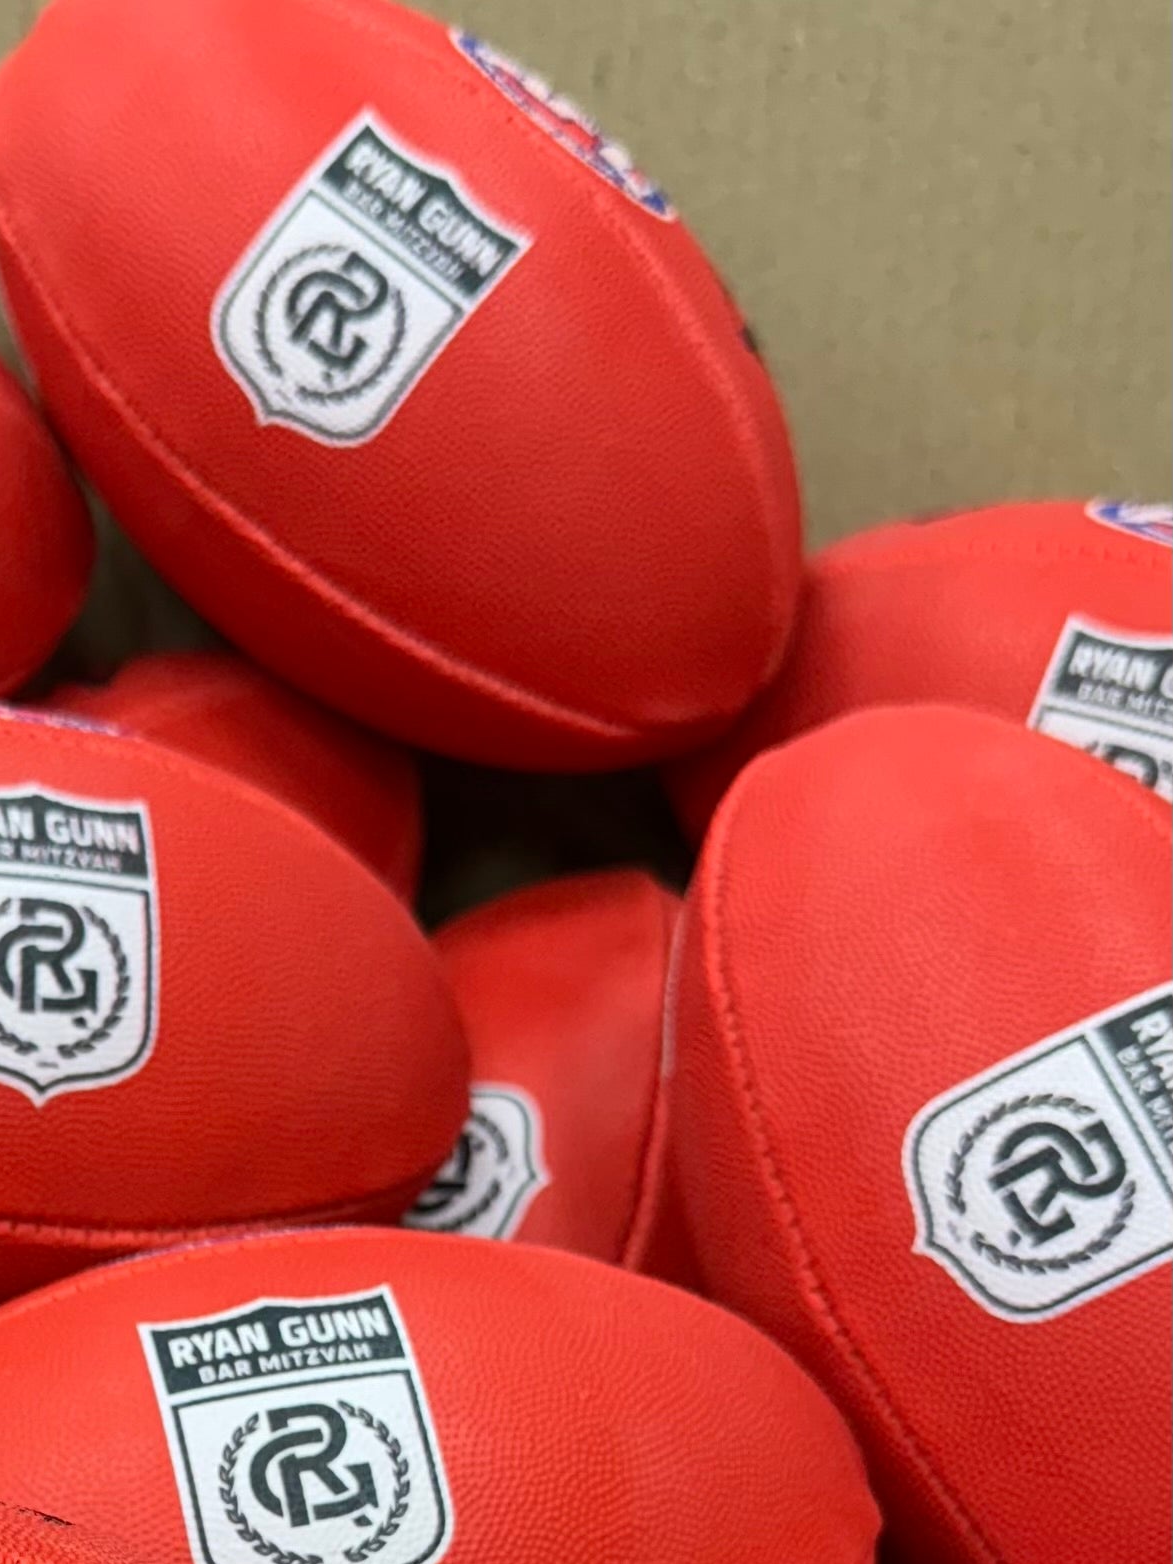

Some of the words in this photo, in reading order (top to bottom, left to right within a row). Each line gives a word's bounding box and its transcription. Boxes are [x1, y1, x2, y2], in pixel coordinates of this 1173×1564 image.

[344, 143, 426, 212] RYAN
[418, 201, 501, 278] GUNN
[1069, 643, 1159, 690] RYAN
[45, 811, 140, 855] GUNN
[21, 845, 122, 873] MITZVAH
[167, 1321, 270, 1369] RYAN
[278, 1306, 392, 1349] GUNN
[198, 1358, 253, 1385] BAR
[258, 1343, 374, 1374] MITZVAH
